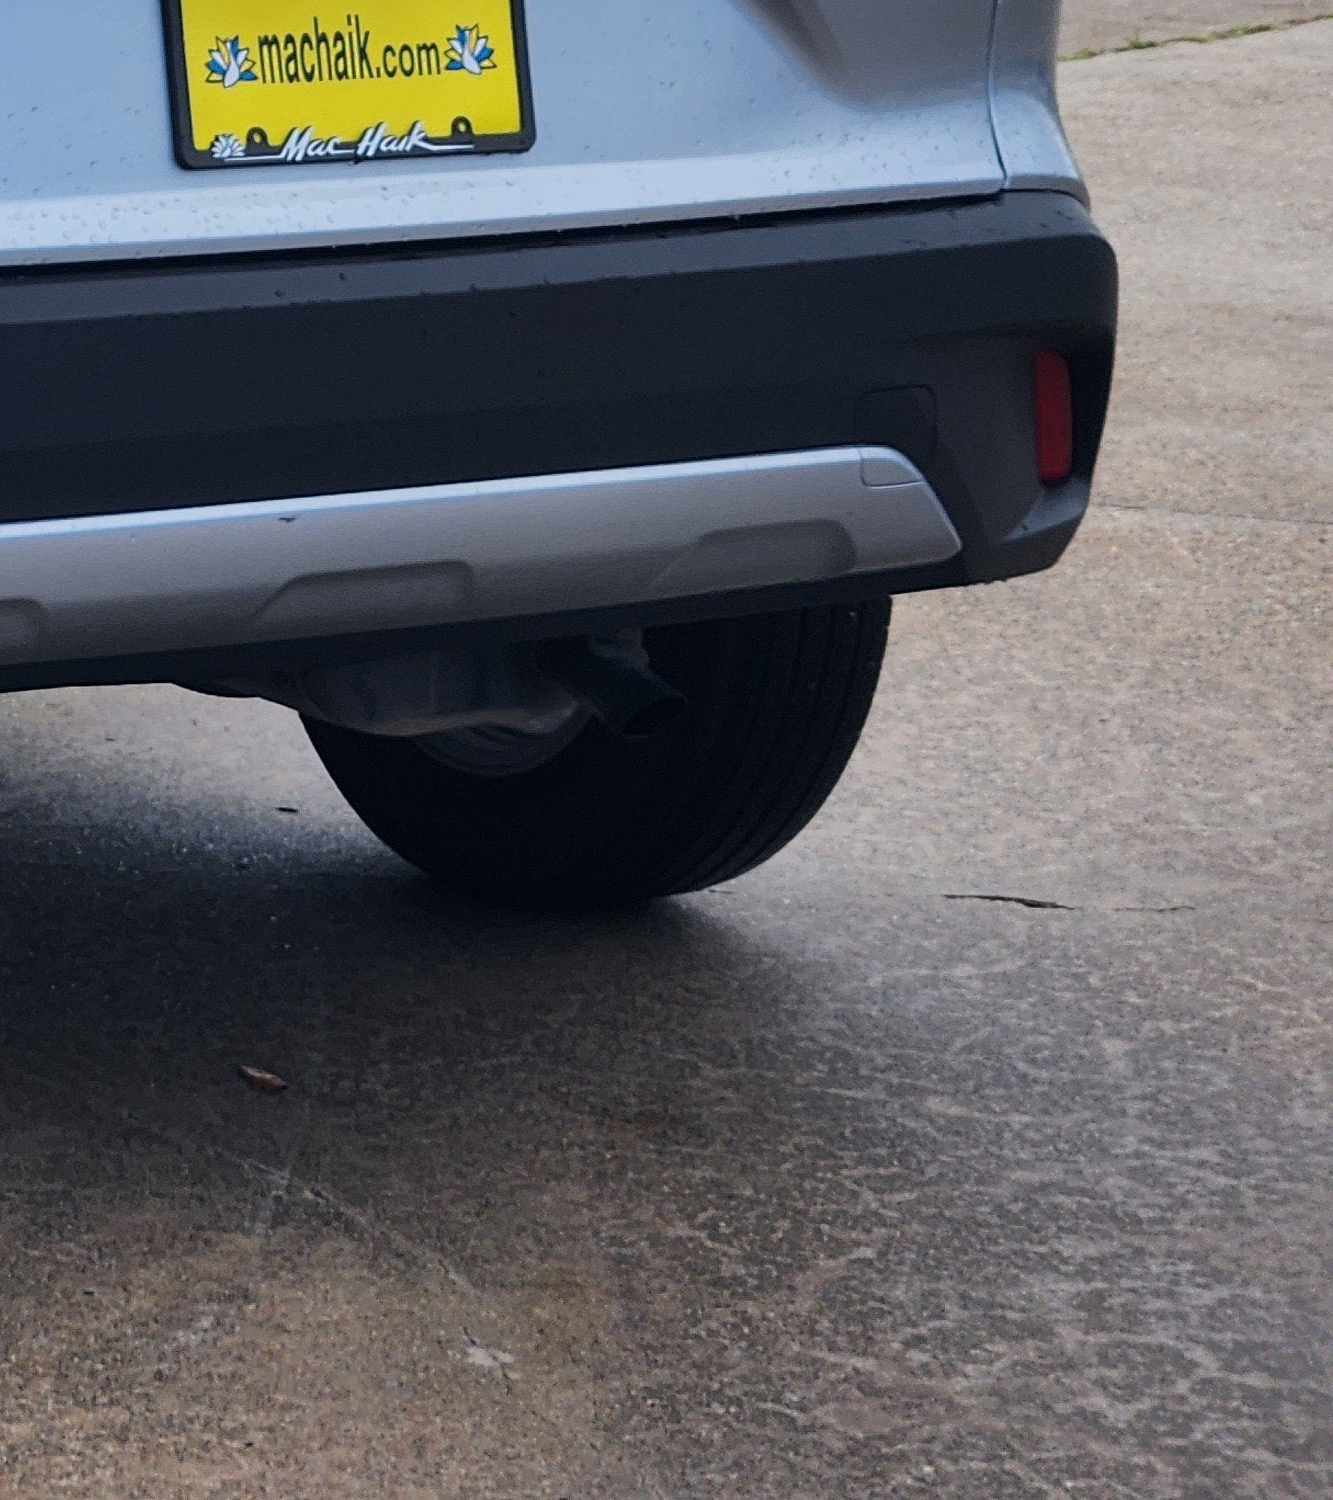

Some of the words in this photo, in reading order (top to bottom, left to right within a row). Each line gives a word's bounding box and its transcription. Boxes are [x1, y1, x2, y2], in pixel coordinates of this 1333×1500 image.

[257, 13, 442, 84] machaik.com
[275, 126, 354, 162] Mac
[355, 119, 451, 158] Haik
